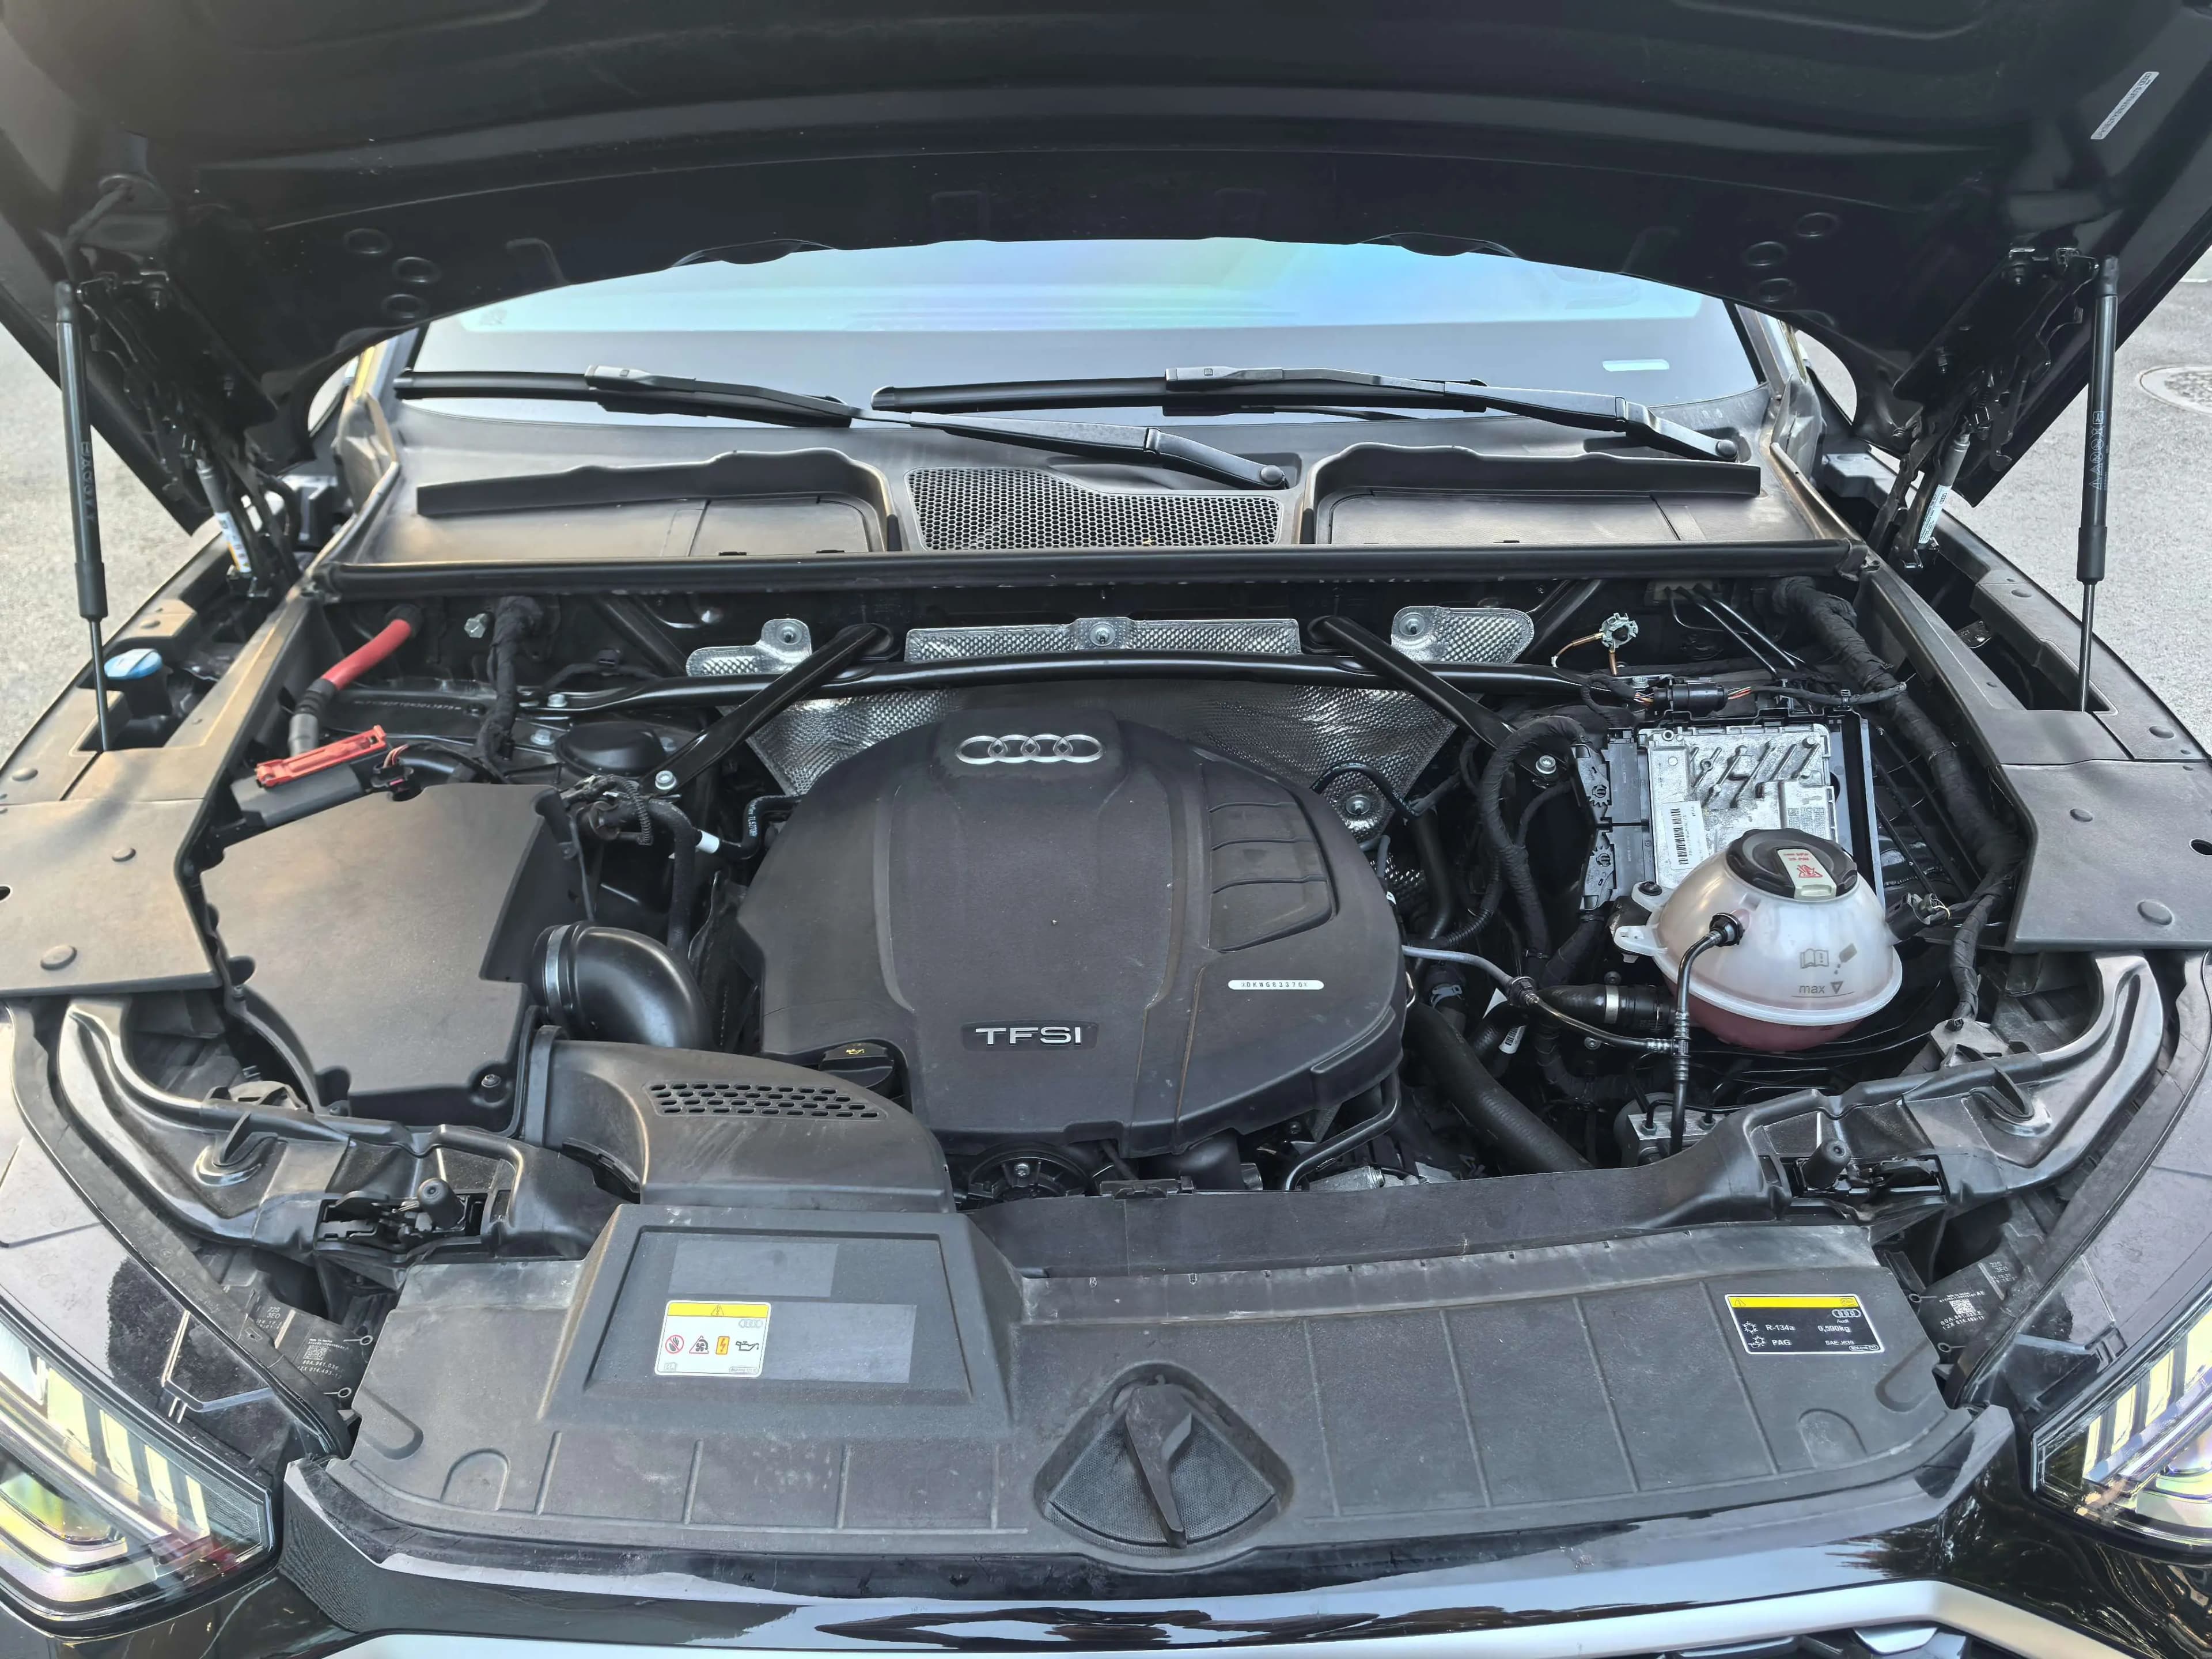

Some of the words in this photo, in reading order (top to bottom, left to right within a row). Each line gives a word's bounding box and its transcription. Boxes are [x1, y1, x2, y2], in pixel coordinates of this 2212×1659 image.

[1798, 985, 1825, 994] max
[975, 1026, 1082, 1046] TFSI
[1817, 1325, 1851, 1333] 0,590kg
